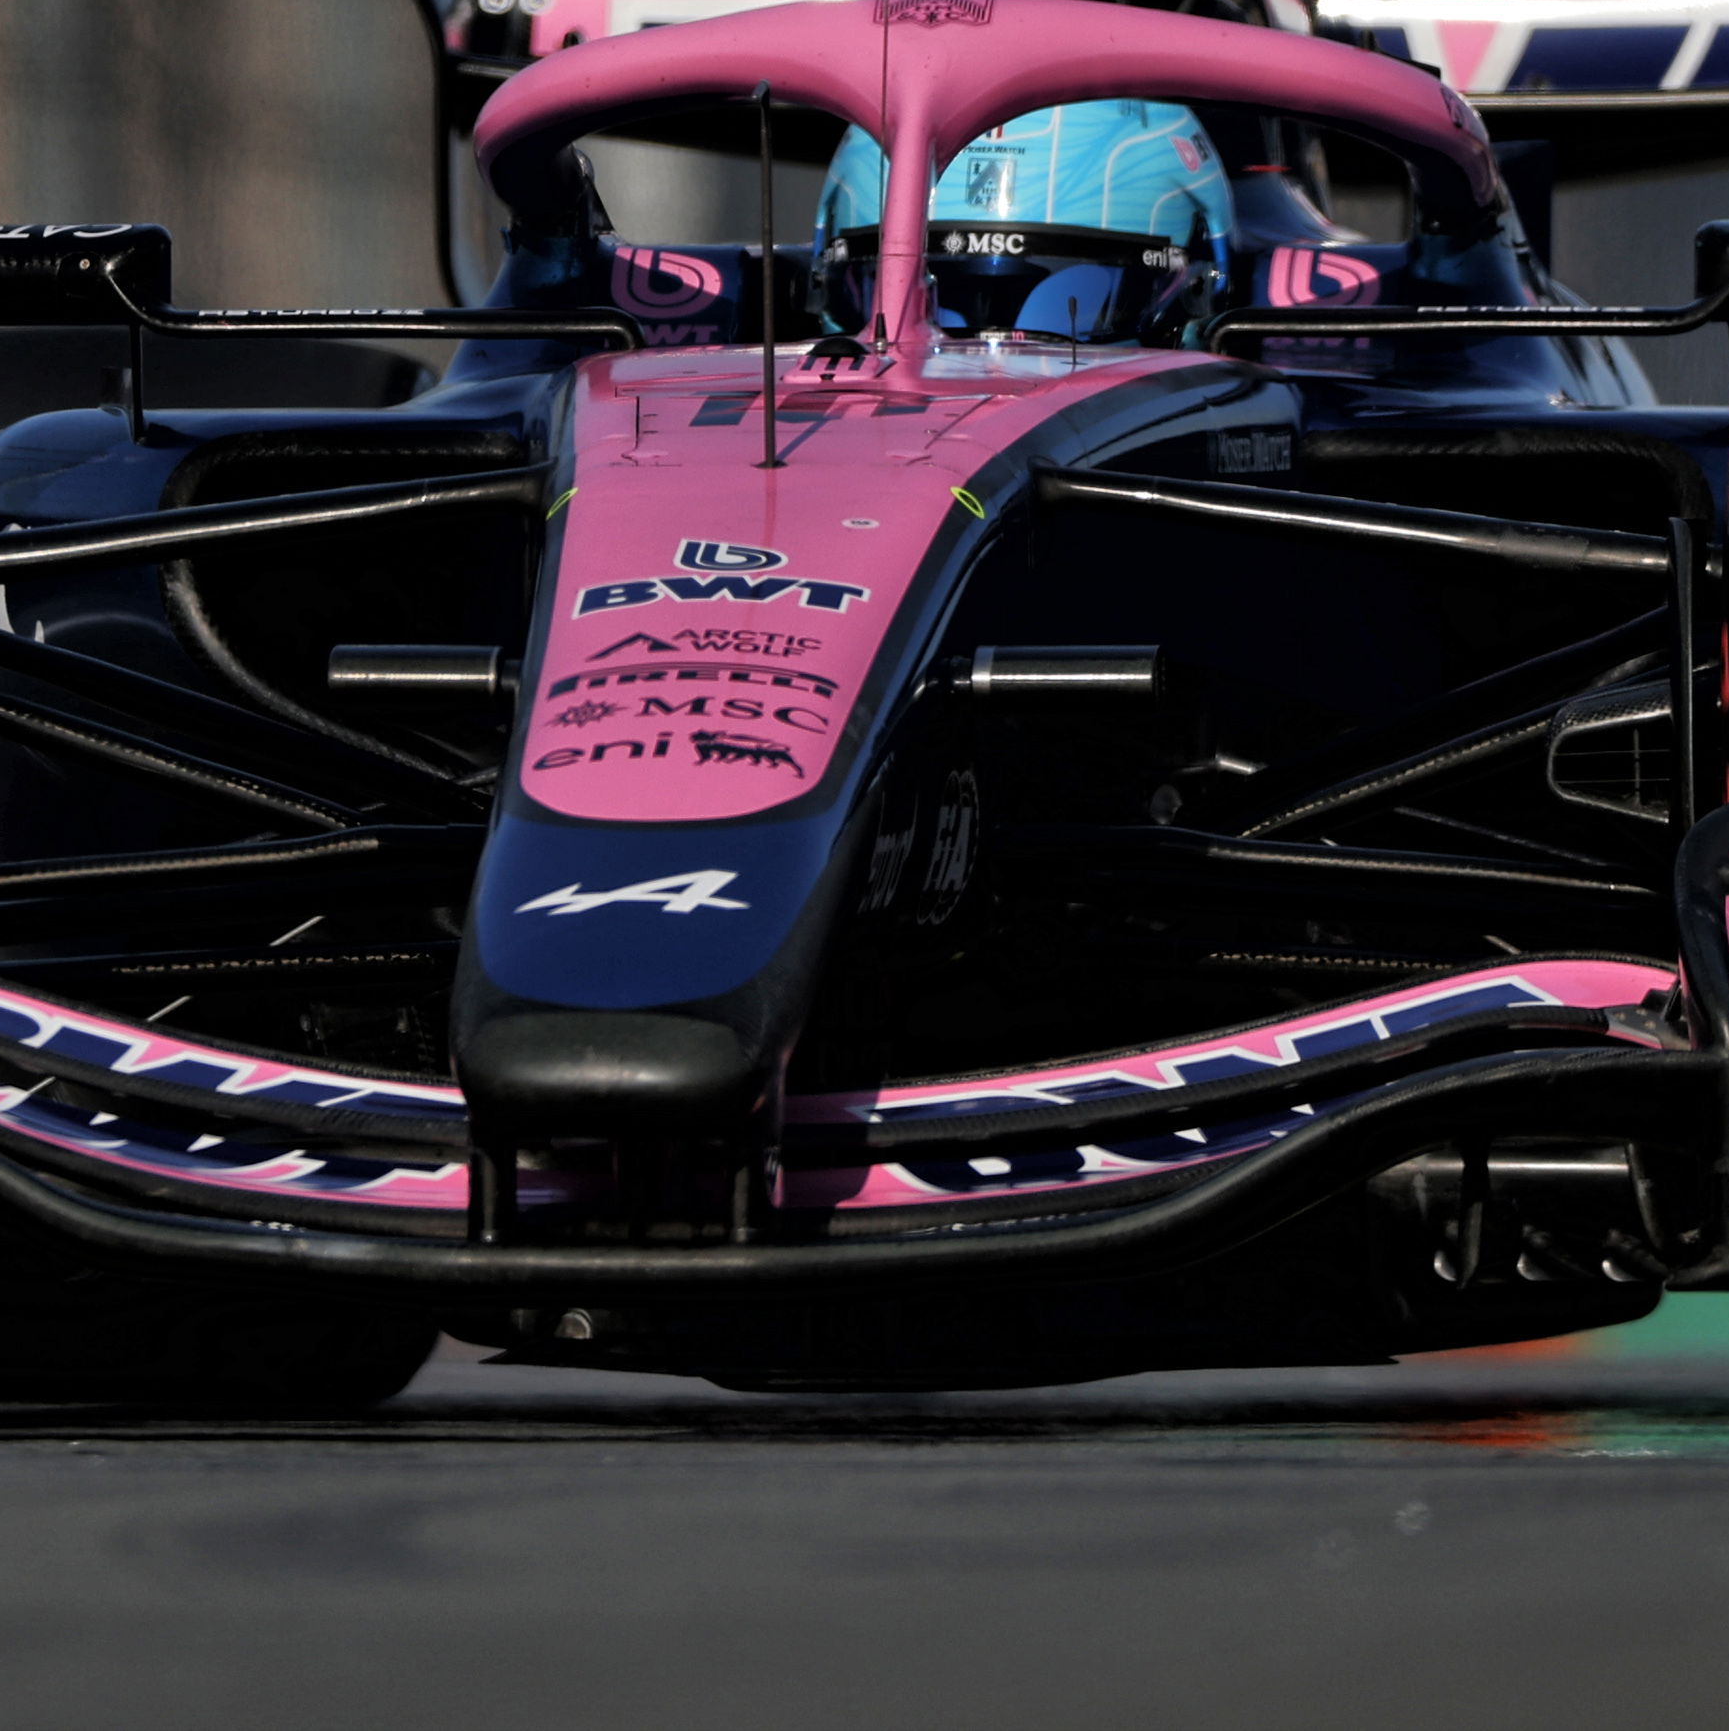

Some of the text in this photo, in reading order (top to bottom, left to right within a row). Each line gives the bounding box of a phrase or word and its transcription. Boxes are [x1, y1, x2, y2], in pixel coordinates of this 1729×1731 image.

[966, 232, 1025, 255] MSC
[1141, 246, 1168, 268] eni
[572, 574, 871, 619] BWT
[671, 628, 824, 650] ARCTIC
[690, 640, 808, 658] WOLF
[547, 661, 839, 700] PIRELLI
[634, 696, 830, 735] MSC
[532, 732, 675, 771] eni
